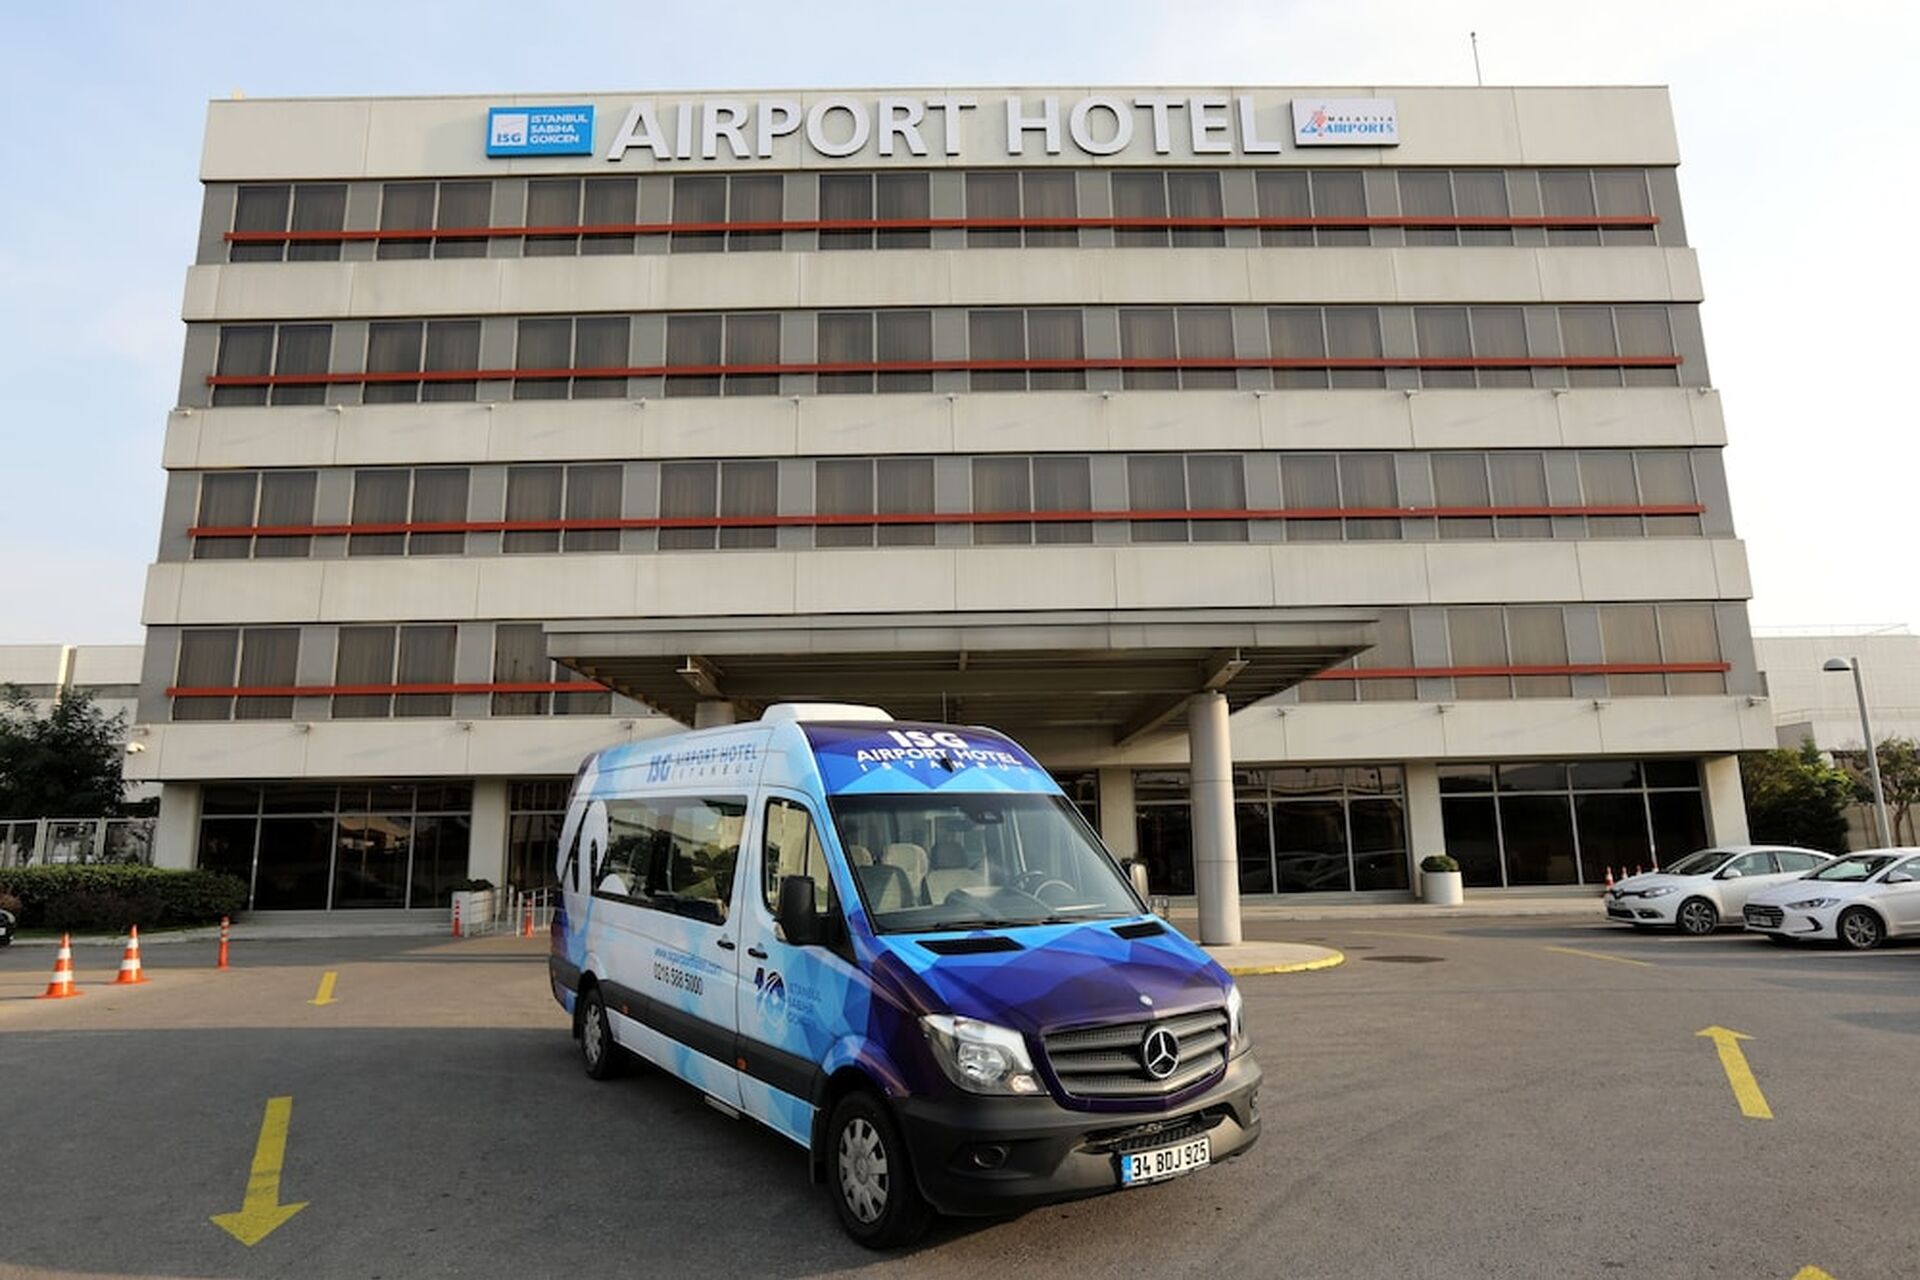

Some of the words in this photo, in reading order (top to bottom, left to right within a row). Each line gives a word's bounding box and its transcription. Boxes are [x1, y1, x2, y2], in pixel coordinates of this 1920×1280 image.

[530, 114, 588, 123] ISTANBUL
[496, 131, 521, 143] ISG
[530, 124, 575, 134] SABIHA
[607, 97, 976, 161] AIRPORT
[1006, 96, 1281, 156] HOTEL
[1324, 123, 1394, 133] AIRPORTS
[887, 730, 969, 749] ISG
[675, 747, 717, 765] AIRPORT
[720, 743, 758, 763] HOTEL
[857, 748, 947, 763] AIRPORT
[953, 748, 1022, 765] HOTEL
[646, 753, 673, 783] ISG
[1132, 1155, 1151, 1177] 34
[1184, 1141, 1207, 1165] 925
